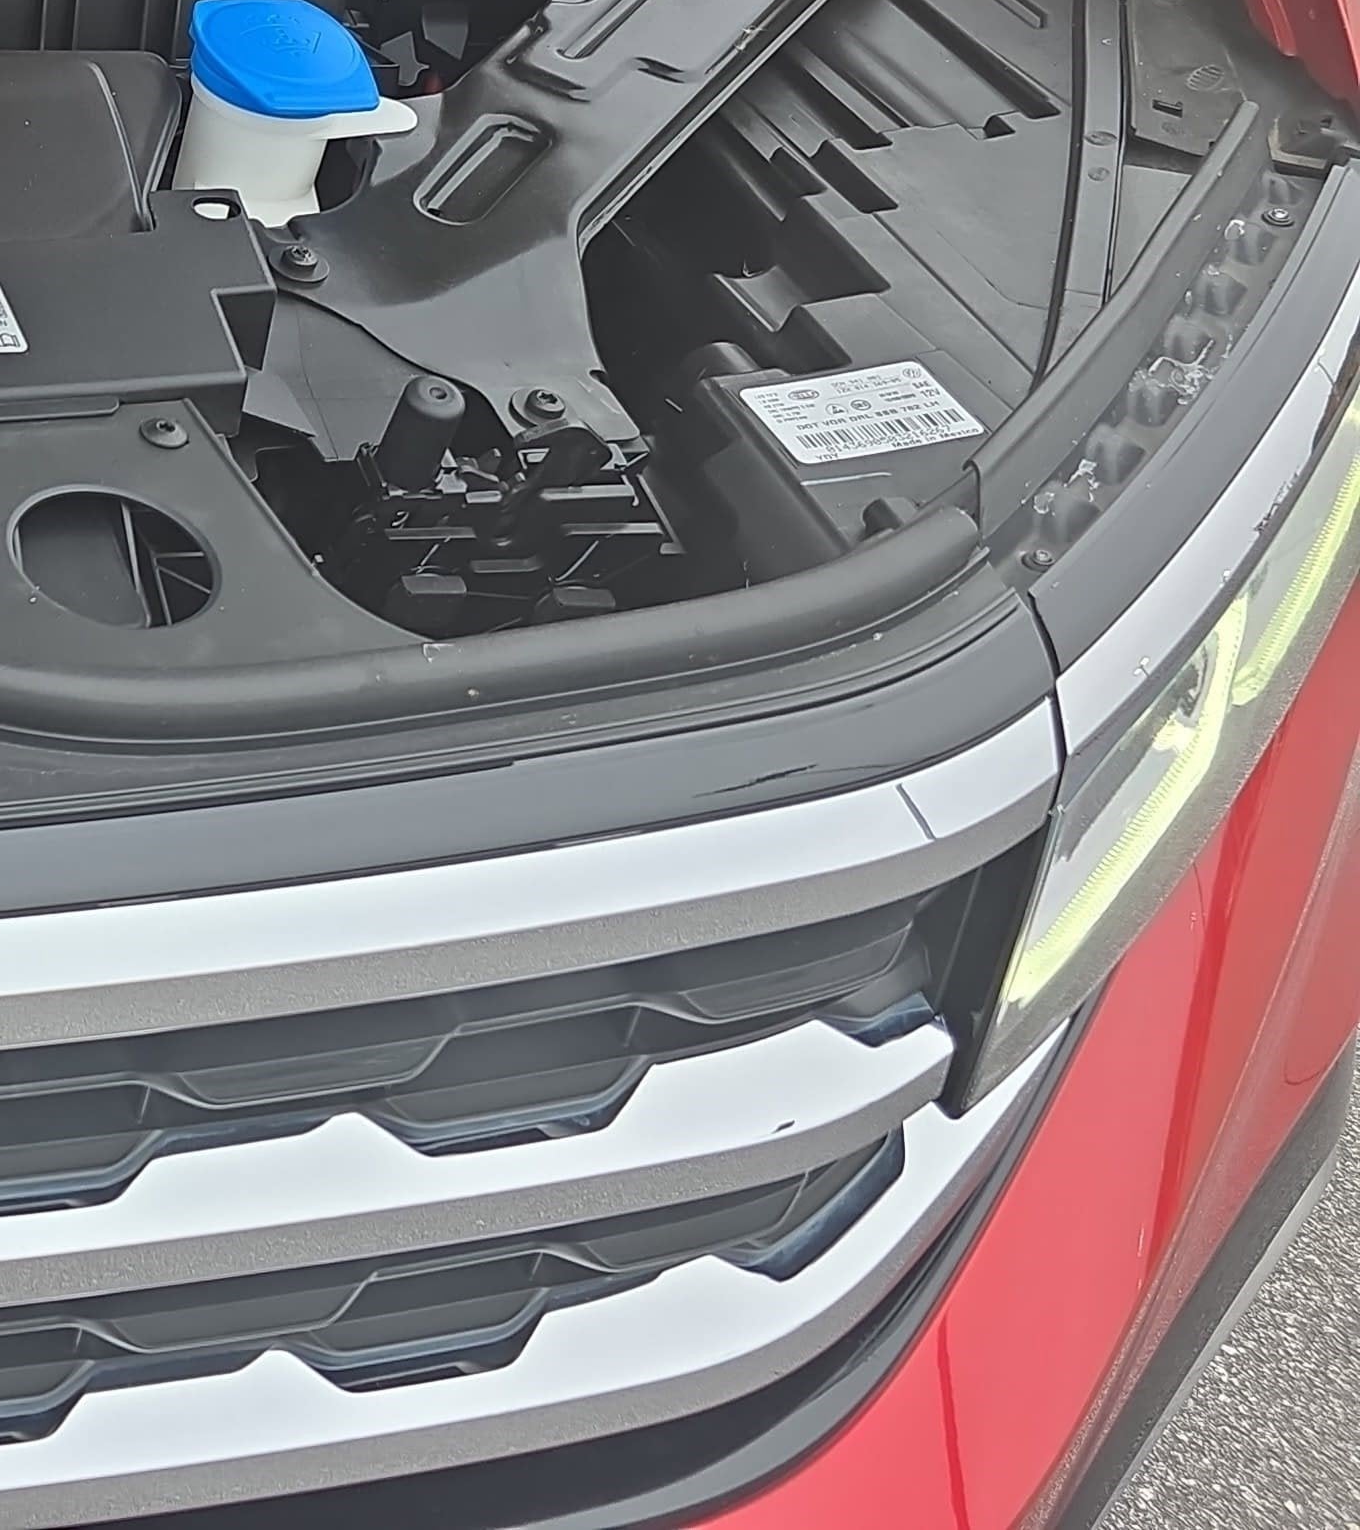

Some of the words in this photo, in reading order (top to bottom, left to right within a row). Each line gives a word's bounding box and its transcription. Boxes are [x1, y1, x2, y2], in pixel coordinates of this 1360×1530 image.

[892, 437, 922, 449] Made
[924, 435, 937, 444] in
[938, 427, 979, 443] Mexico
